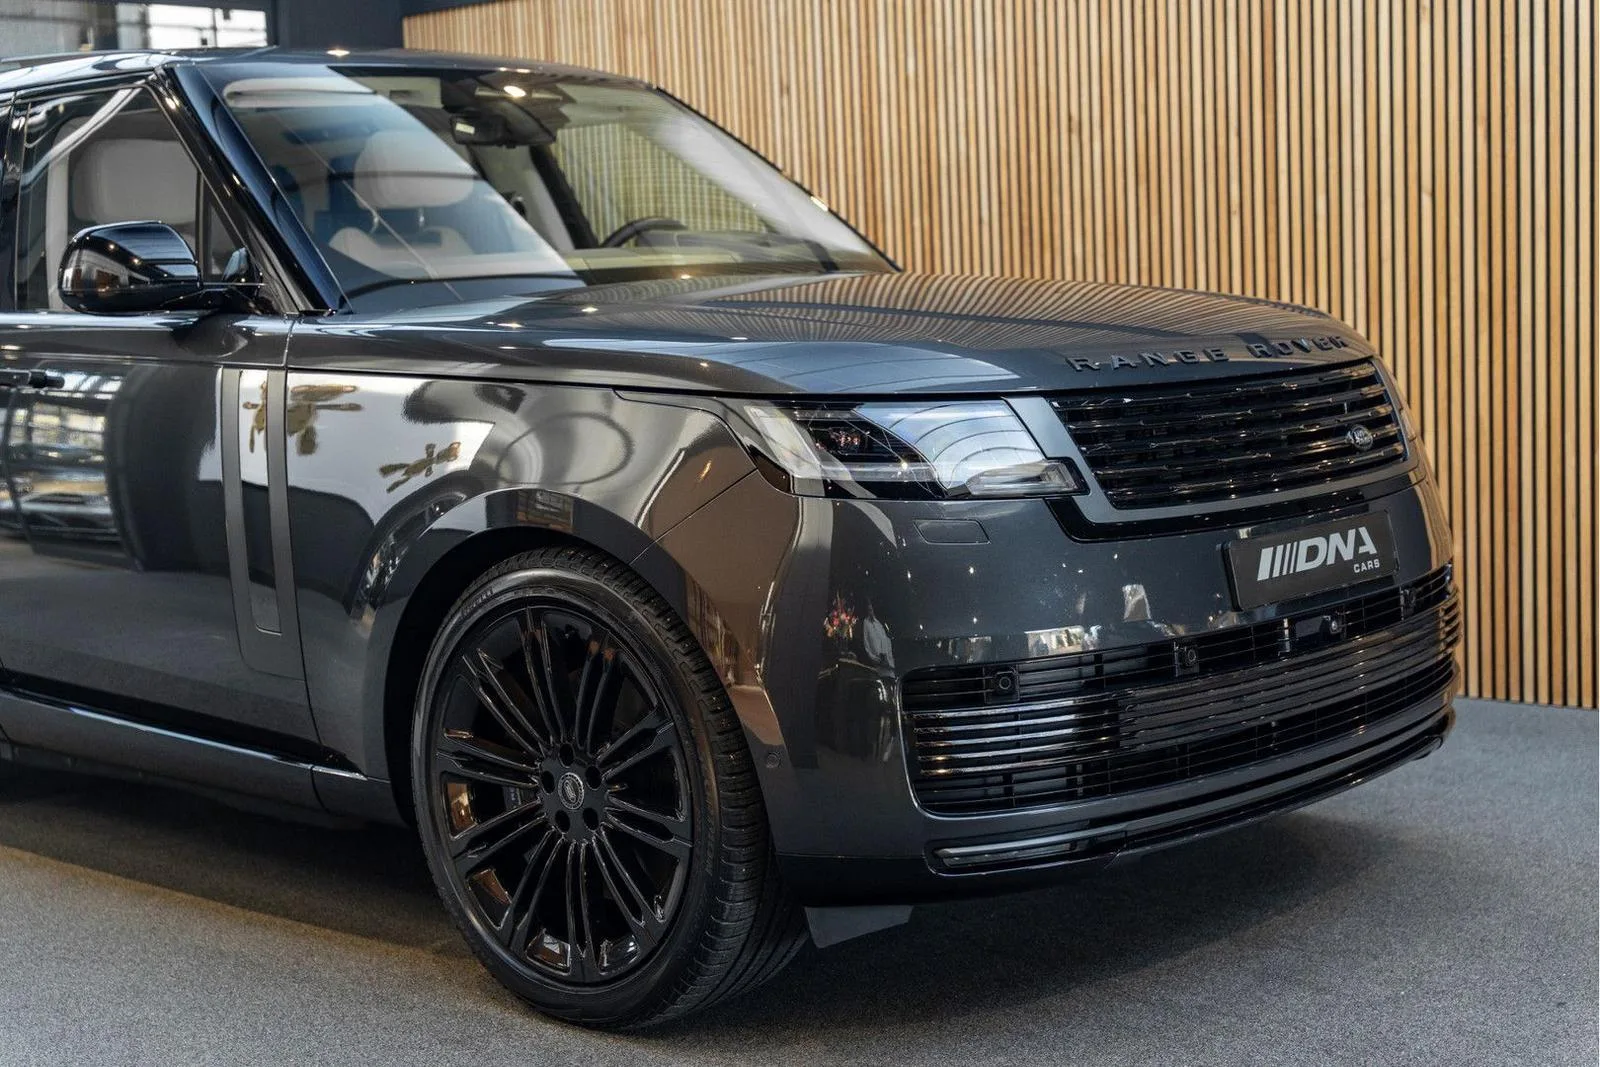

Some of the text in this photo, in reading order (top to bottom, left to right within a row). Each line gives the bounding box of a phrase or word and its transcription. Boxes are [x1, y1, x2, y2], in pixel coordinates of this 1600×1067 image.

[1065, 336, 1348, 372] RANGE ROVER
[1295, 526, 1378, 573] DNA
[1353, 558, 1381, 574] CARS
